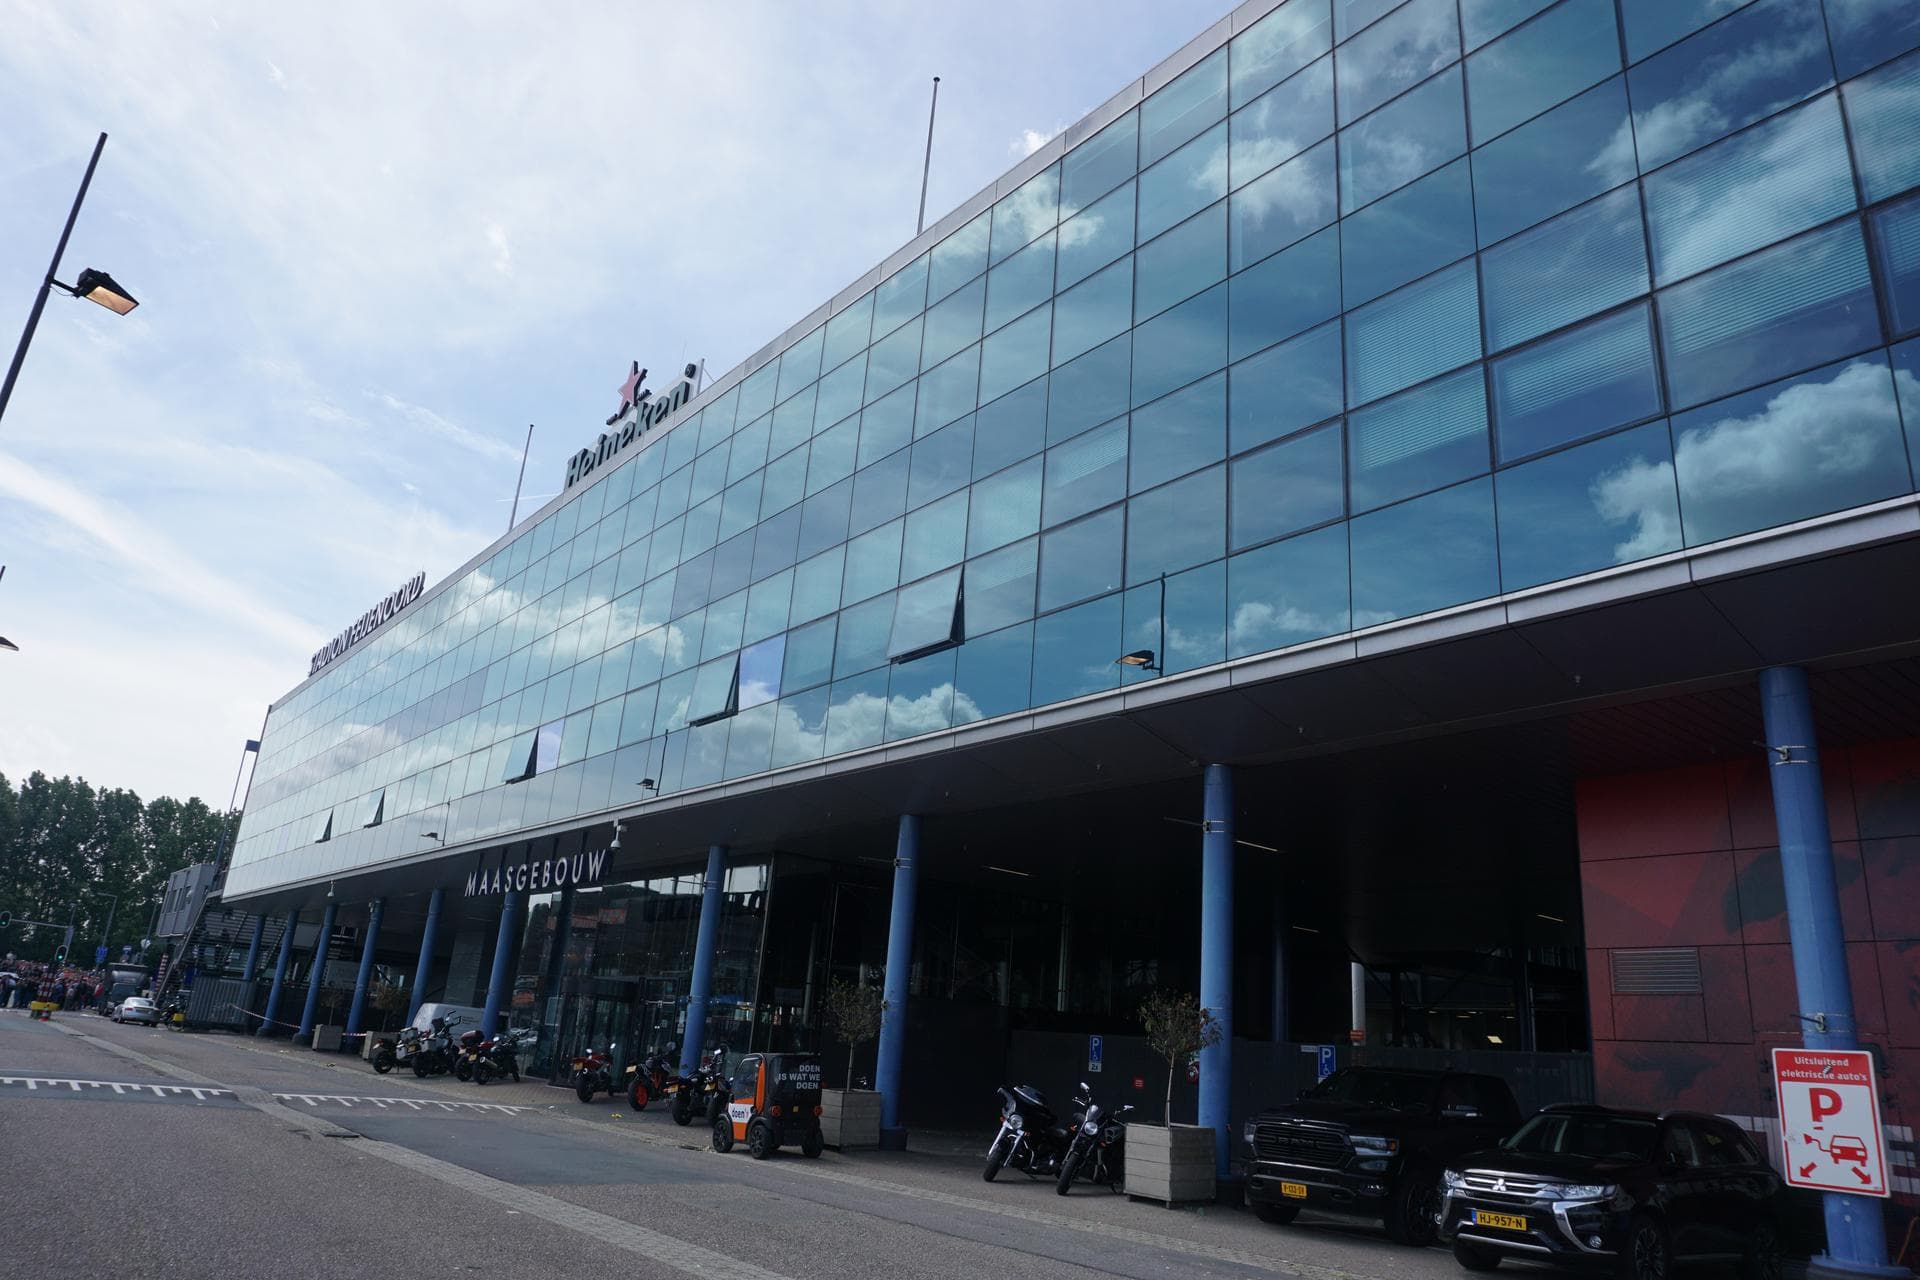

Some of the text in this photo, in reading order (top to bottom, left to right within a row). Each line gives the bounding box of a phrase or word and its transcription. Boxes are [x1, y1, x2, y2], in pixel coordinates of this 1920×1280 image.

[564, 381, 690, 491] Heineken
[465, 850, 606, 897] MAASGEBOUW
[1092, 1037, 1100, 1051] P
[1321, 1047, 1332, 1063] P
[1794, 1056, 1849, 1067] Uitsluitend
[799, 1064, 821, 1073] DOEN
[1781, 1069, 1867, 1082] elektrische auto's
[778, 1073, 821, 1081] IS WAT WE
[796, 1081, 819, 1090] DOEN
[1809, 1087, 1843, 1130] P
[1479, 1213, 1523, 1228] HJ-957-N
